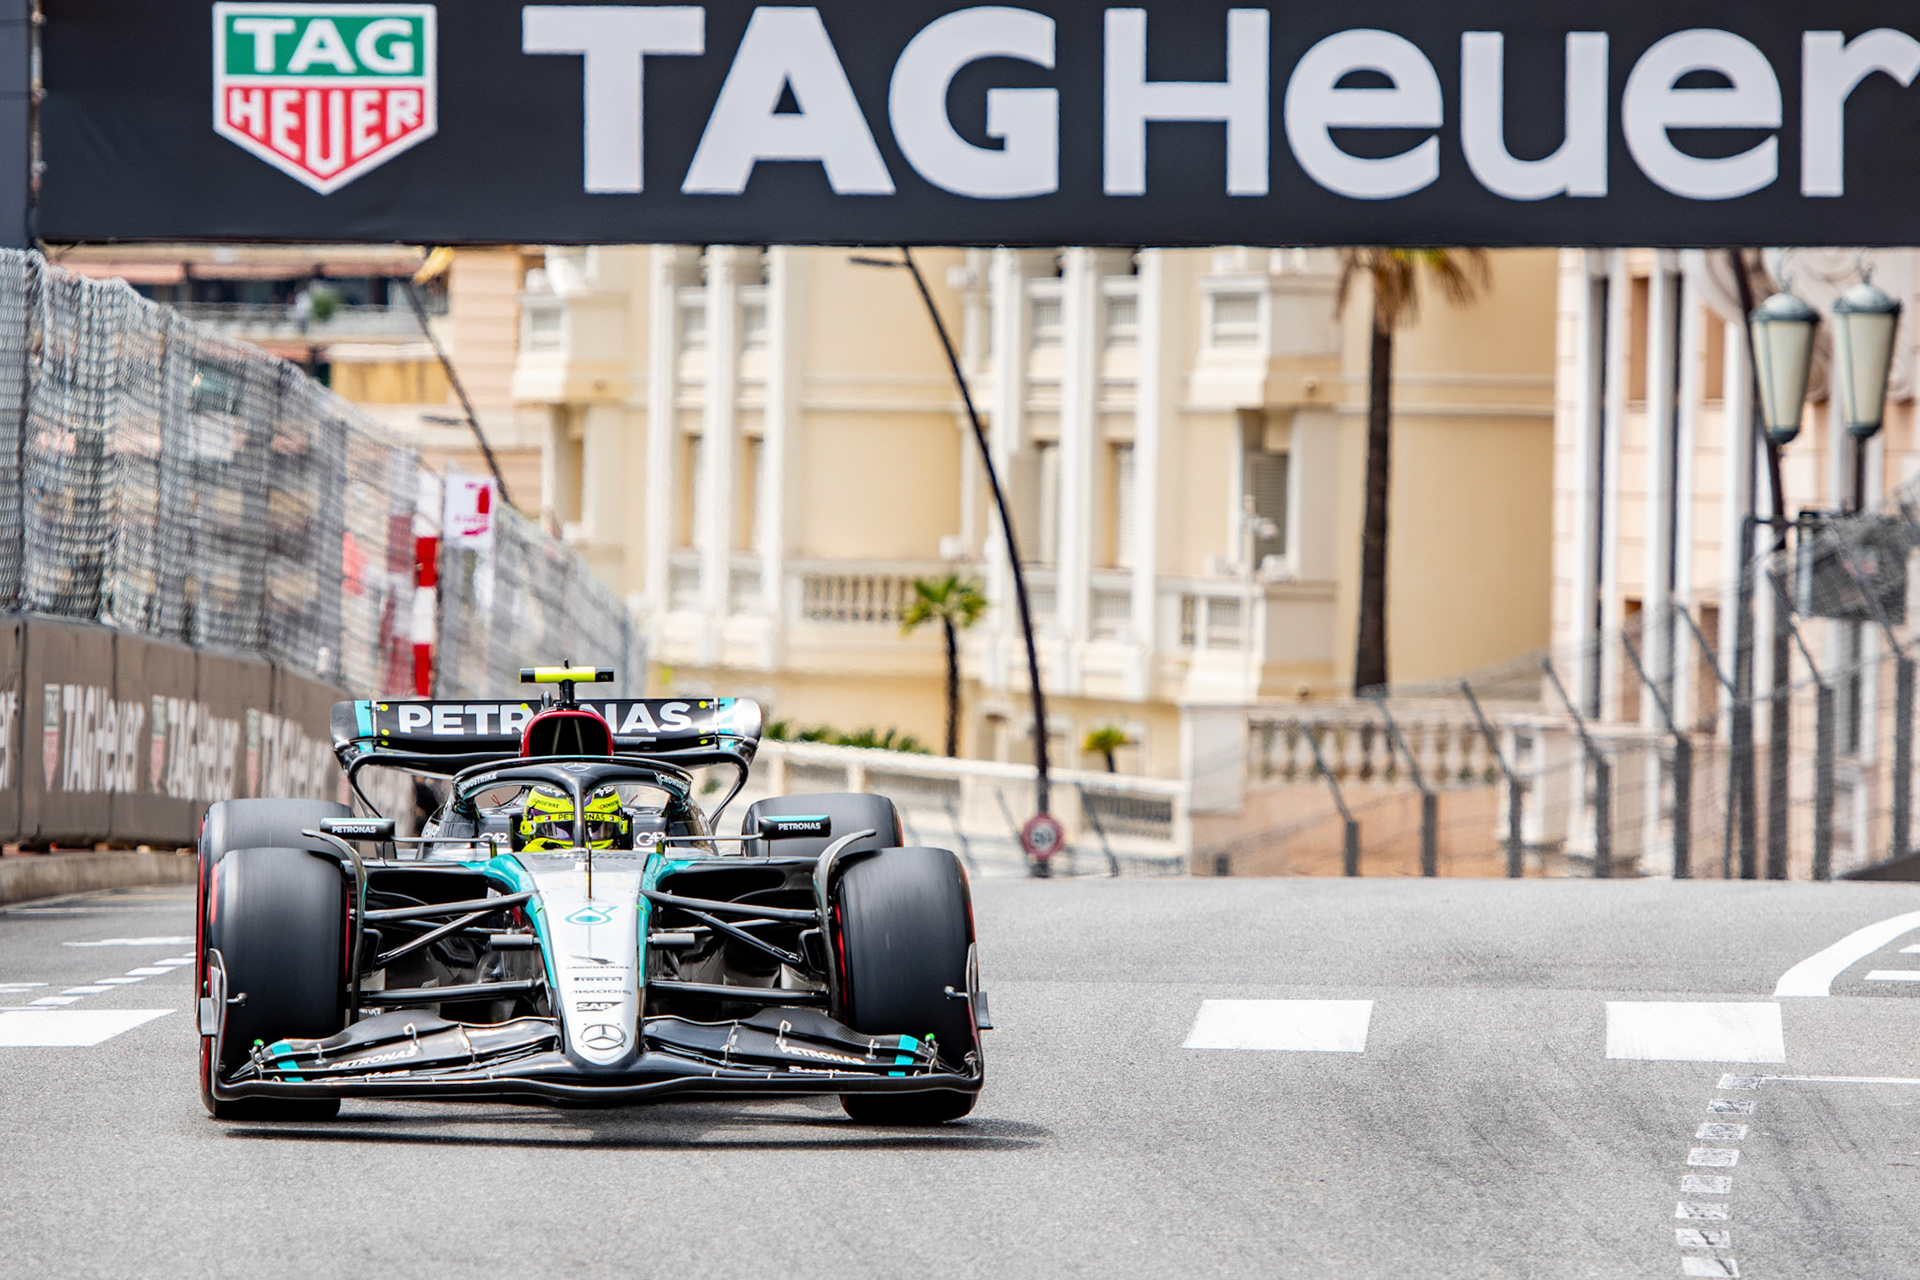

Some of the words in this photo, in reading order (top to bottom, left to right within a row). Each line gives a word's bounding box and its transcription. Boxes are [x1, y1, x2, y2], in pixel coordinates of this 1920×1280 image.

[233, 17, 415, 74] TAG
[522, 5, 1060, 199] TAG
[1103, 7, 1920, 200] Heuer
[229, 88, 422, 176] HEUER
[397, 701, 692, 736] PETRNAS
[557, 813, 606, 822] PETONAS
[778, 822, 822, 831] PETRONAS
[331, 825, 376, 834] PETRONAS
[576, 1001, 614, 1013] SAP
